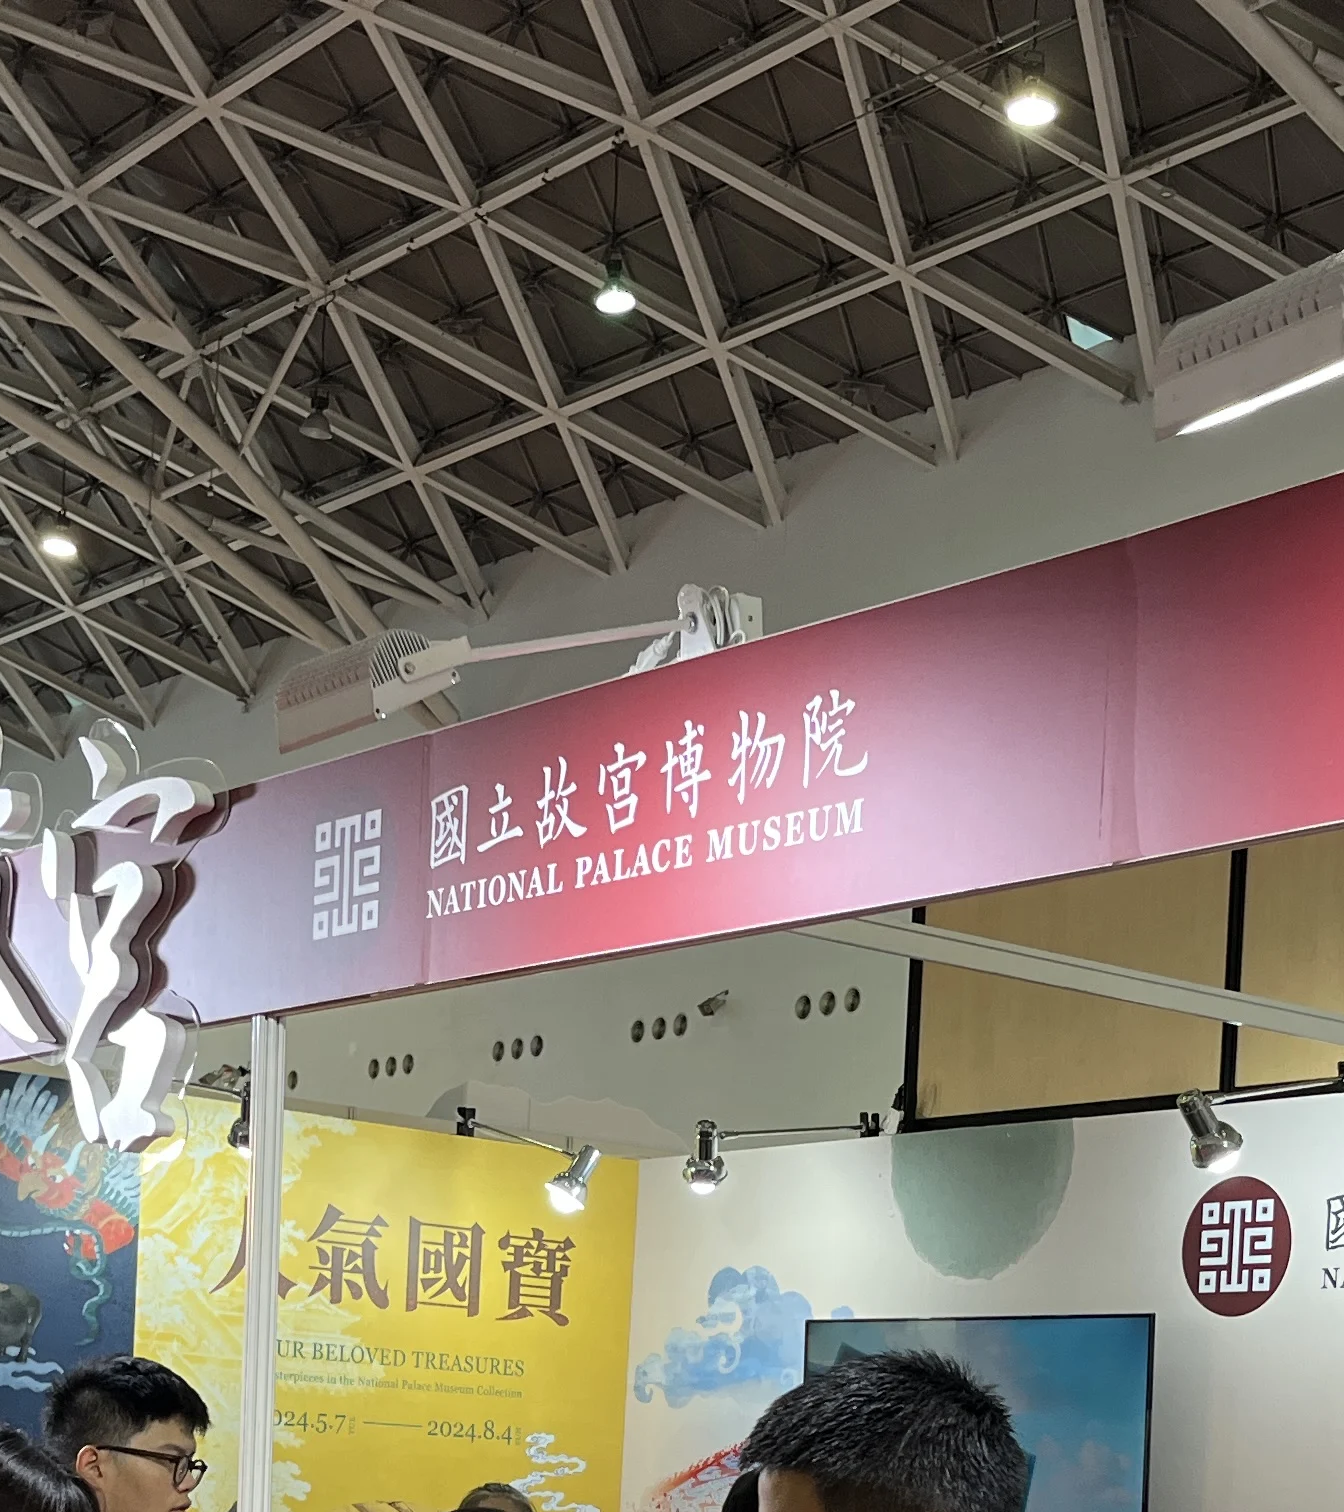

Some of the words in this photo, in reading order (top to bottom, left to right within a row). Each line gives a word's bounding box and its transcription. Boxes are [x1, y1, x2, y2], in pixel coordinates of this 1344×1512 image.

[429, 689, 869, 870] 國立故宮博物院
[426, 862, 564, 919] NATIONAL
[575, 834, 693, 889] PALACE
[706, 797, 865, 863] MUSEUM
[275, 1339, 306, 1359] UR
[311, 1342, 406, 1368] BELOVED
[411, 1350, 525, 1378] TREASURES
[274, 1371, 325, 1385] sterpieces
[327, 1372, 337, 1385] in
[340, 1373, 355, 1386] the
[358, 1375, 399, 1389] National
[401, 1379, 432, 1393] Palace
[434, 1382, 474, 1395] Museum
[476, 1385, 523, 1399] Collection
[273, 1409, 347, 1435] 024.5.7
[427, 1419, 513, 1446] 2024.8.4
